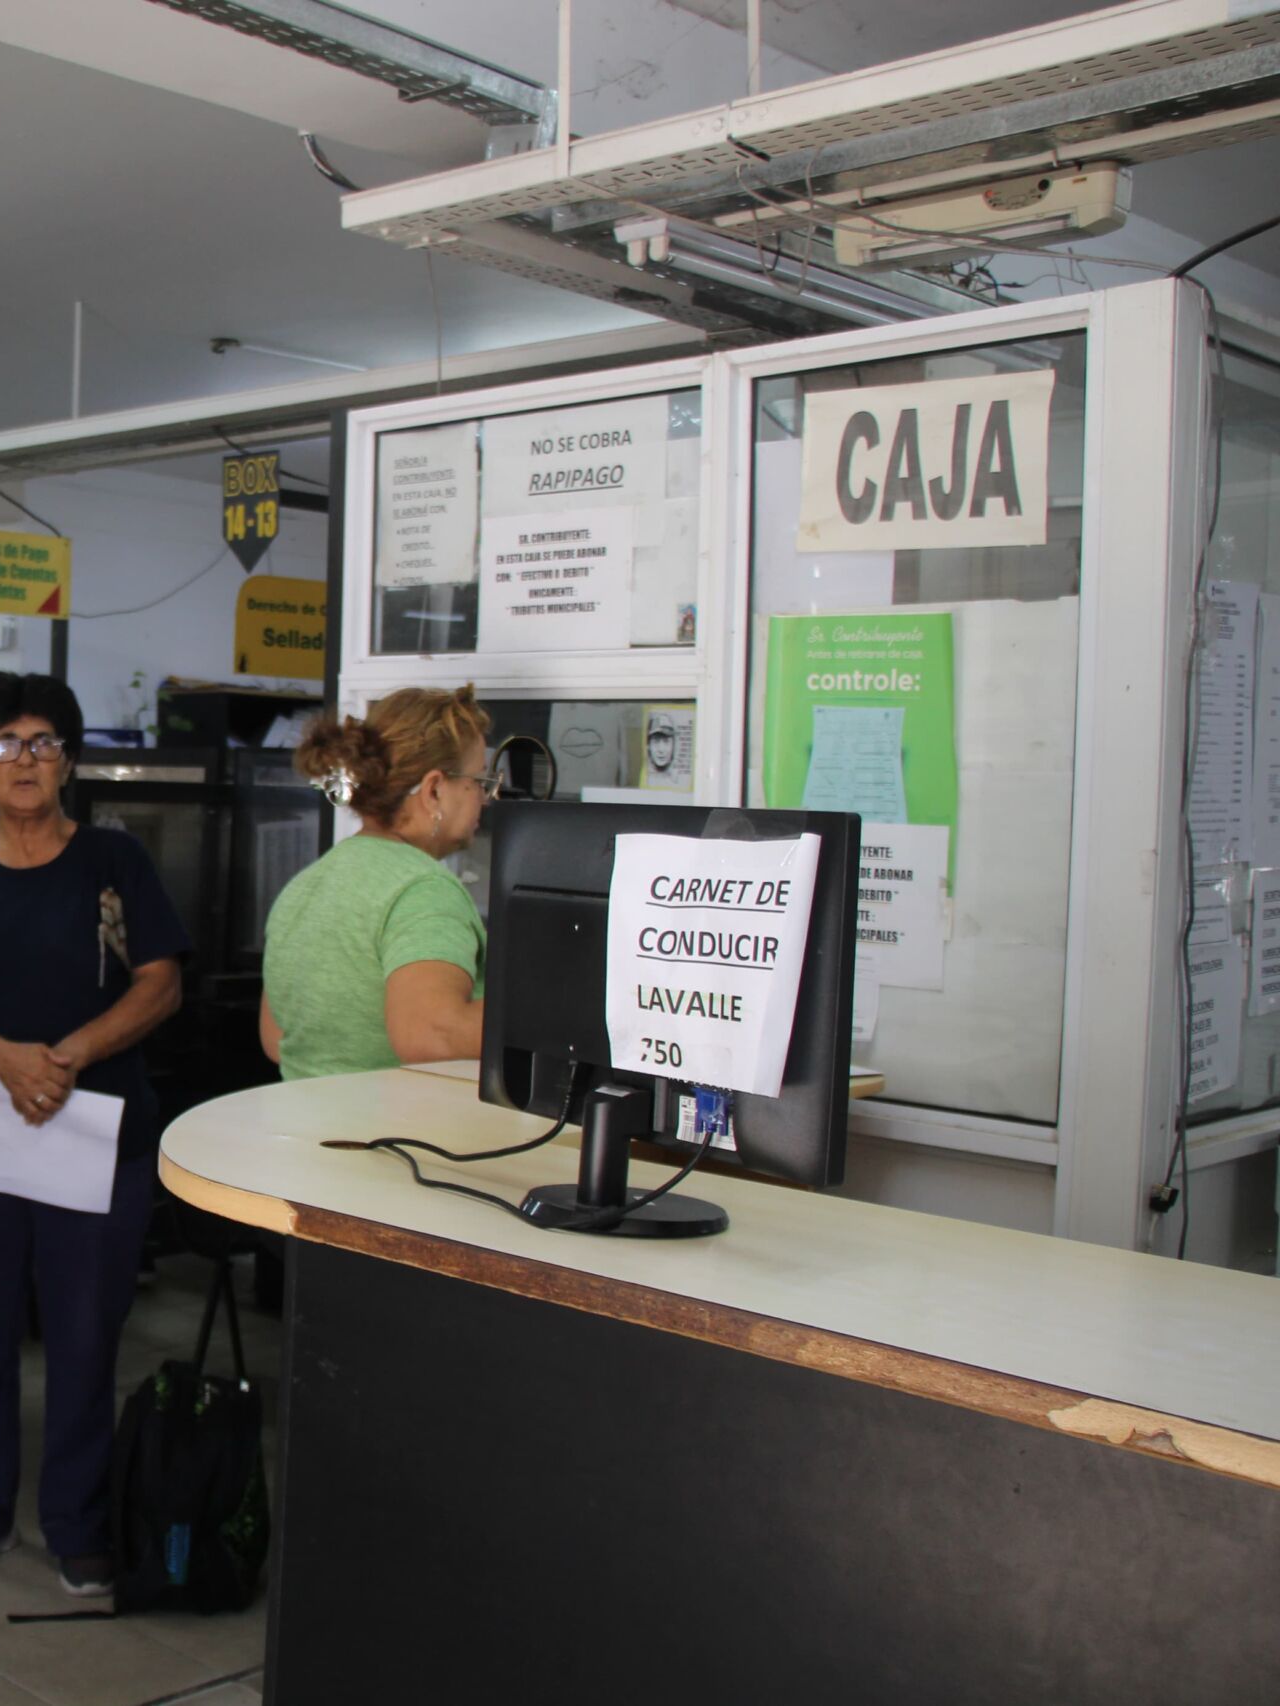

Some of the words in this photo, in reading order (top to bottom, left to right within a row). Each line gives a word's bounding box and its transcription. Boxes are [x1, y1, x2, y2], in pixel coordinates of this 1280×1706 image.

[531, 439, 554, 456] NO
[558, 436, 575, 453] SE
[580, 429, 633, 450] COBRA
[836, 400, 1022, 525] CAJA
[224, 455, 279, 498] BOX
[528, 464, 625, 493] RAPIPAGO
[4, 543, 18, 559] de
[21, 544, 50, 563] Pago
[496, 555, 505, 565] EN
[506, 553, 522, 564] ESTA
[524, 552, 541, 563] CAJA
[543, 551, 551, 561] SE
[553, 549, 575, 560] PUEDE
[577, 546, 607, 558] ABONAR
[10, 563, 58, 583] Cuentas
[247, 597, 299, 614] Derecho
[302, 602, 316, 616] de
[263, 626, 327, 650] Sellad
[806, 668, 921, 692] controle:
[860, 846, 893, 859] YENTE:
[873, 868, 914, 881] ABONAR
[650, 875, 754, 905] CARNET
[755, 880, 792, 907] DE
[637, 926, 780, 964] CONDUCIR
[637, 984, 744, 1023] LAVALLE
[640, 1037, 683, 1069] 750
